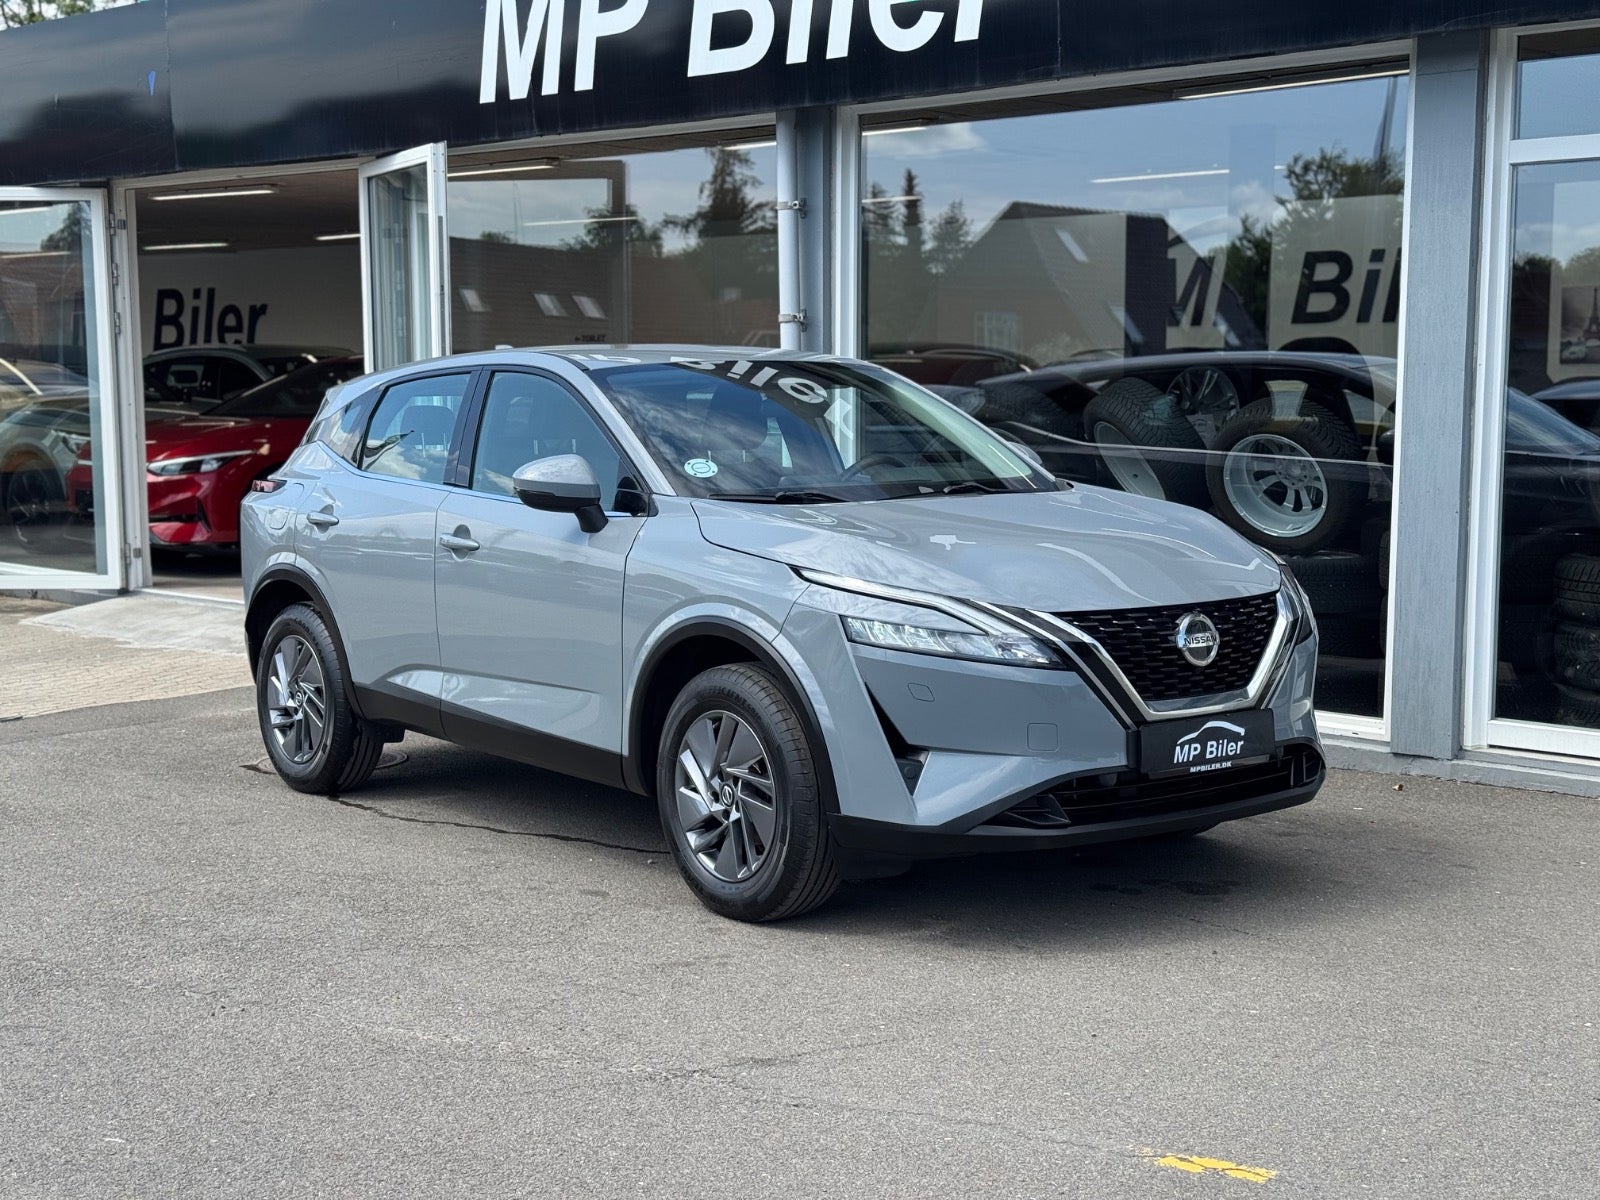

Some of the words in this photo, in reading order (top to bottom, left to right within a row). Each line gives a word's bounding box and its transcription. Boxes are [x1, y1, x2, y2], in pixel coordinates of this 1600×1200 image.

[479, 0, 649, 104] MP
[153, 287, 268, 351] Biler
[1184, 634, 1217, 646] NISSAN
[1173, 743, 1201, 764] MP
[1205, 738, 1245, 760] Biler
[1189, 760, 1233, 773] MPBILER.DK
